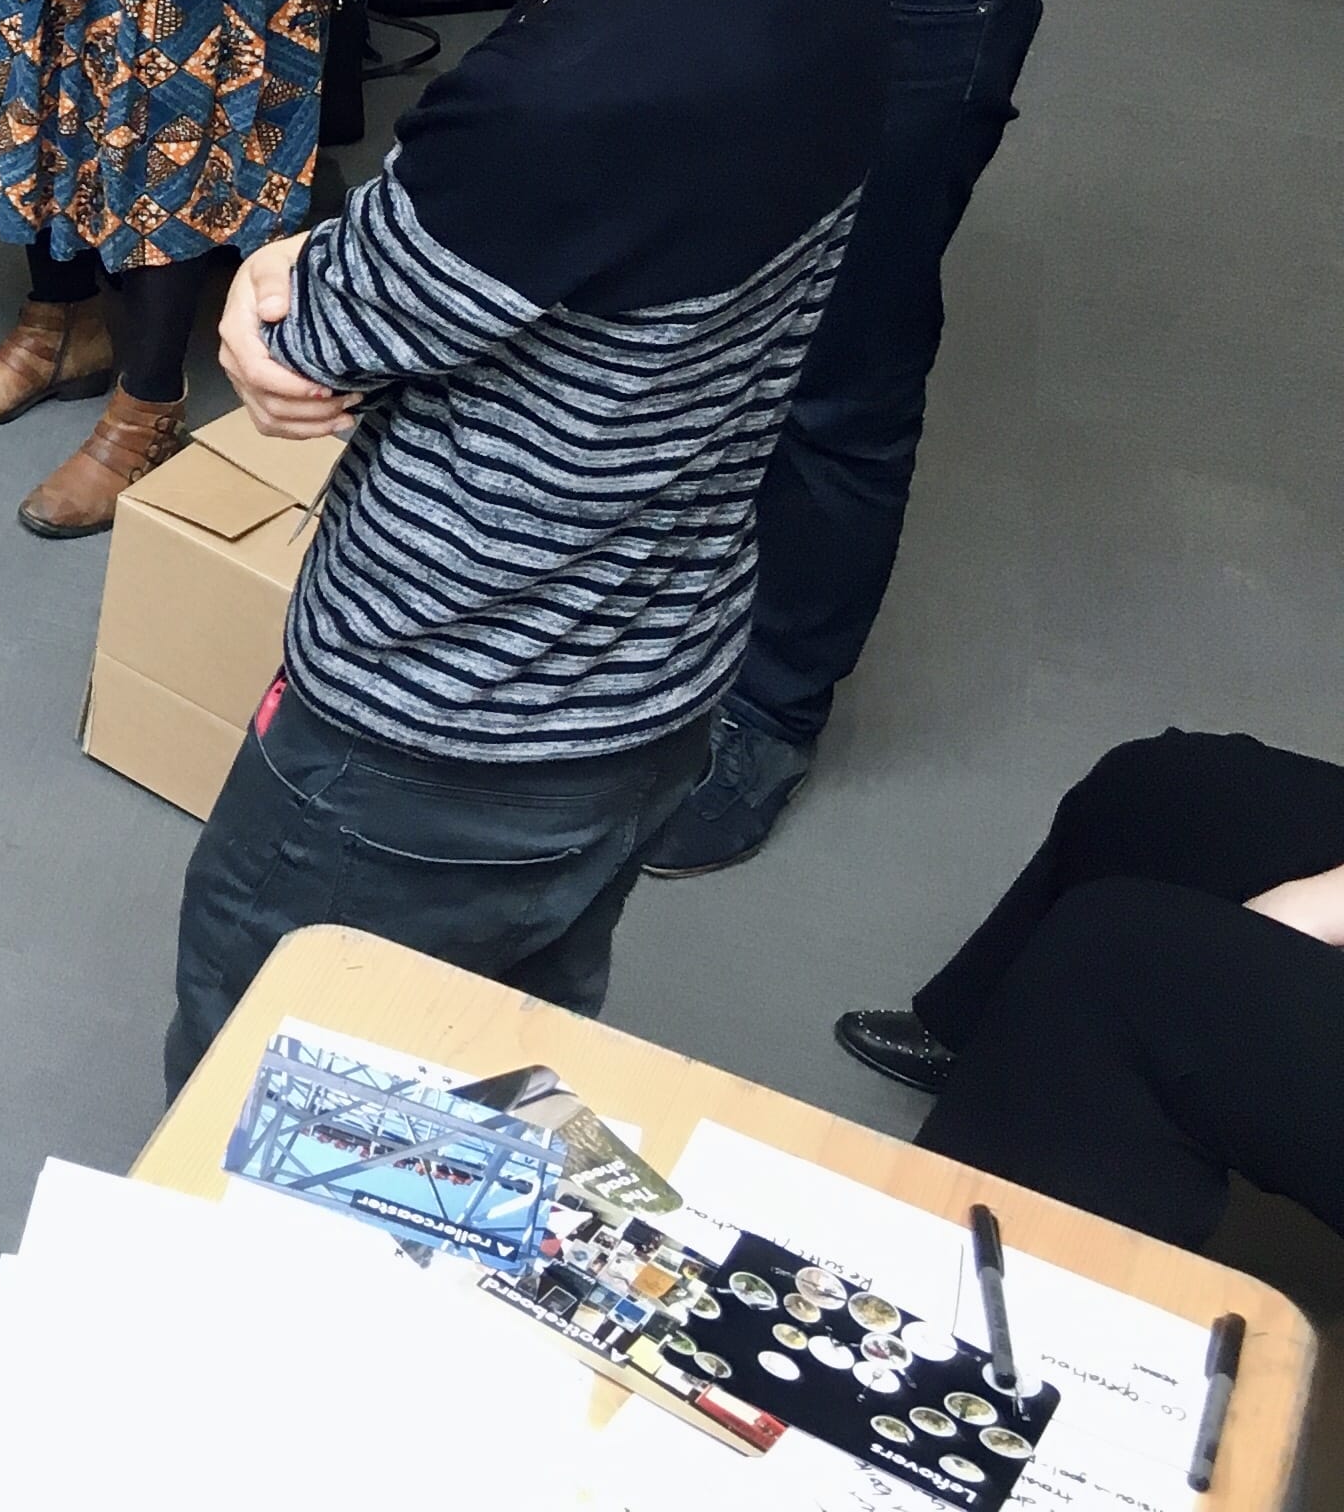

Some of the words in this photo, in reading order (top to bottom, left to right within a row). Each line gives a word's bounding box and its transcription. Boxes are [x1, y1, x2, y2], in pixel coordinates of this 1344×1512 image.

[569, 1159, 626, 1189] ahead
[595, 1172, 640, 1198] road
[620, 1186, 659, 1203] The
[357, 1195, 493, 1249] rollercoaster
[496, 1241, 515, 1257] A
[480, 1276, 608, 1350] noticeboard
[611, 1347, 630, 1363] A
[869, 1442, 978, 1504] Leftovers
